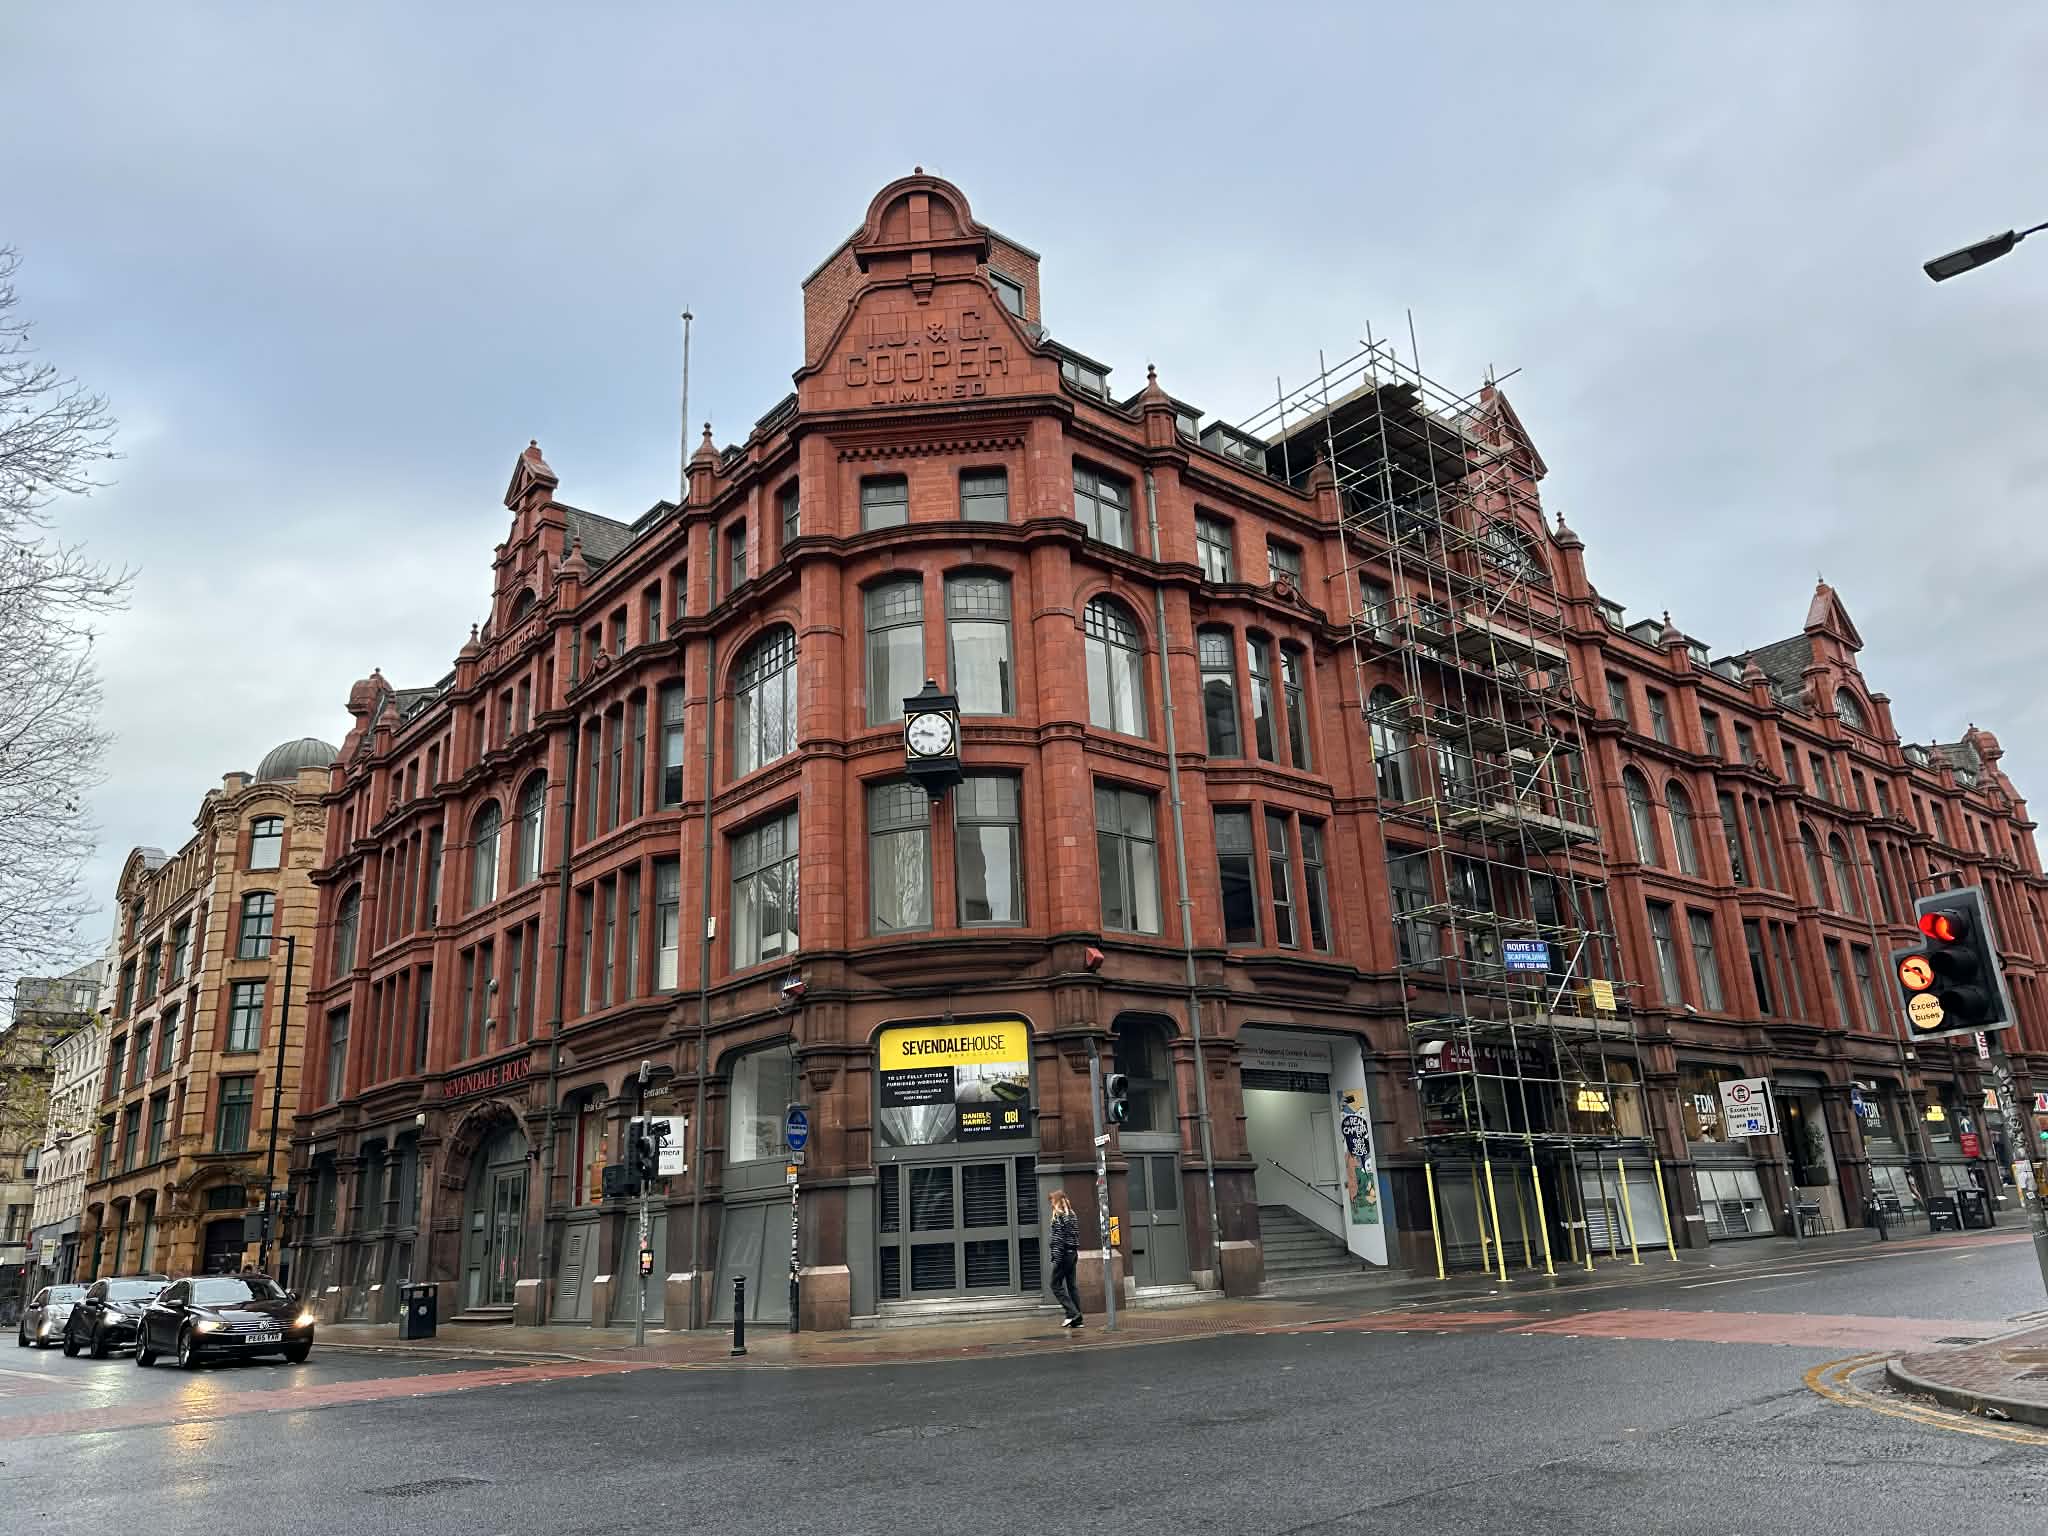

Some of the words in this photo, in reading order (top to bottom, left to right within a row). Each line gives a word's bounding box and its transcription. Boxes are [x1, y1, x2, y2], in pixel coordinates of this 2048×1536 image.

[926, 322, 949, 343] &
[844, 344, 1009, 387] COOPER
[871, 382, 985, 404] LIMITED
[1506, 943, 1530, 952] ROUTE
[1506, 952, 1546, 961] SCAFFOLDING
[1910, 1000, 1940, 1011] Except
[1915, 1013, 1940, 1021] buses
[643, 1086, 669, 1098] Entrance
[1729, 1105, 1748, 1113] Except
[962, 1112, 986, 1120] DANIEL
[1349, 1116, 1366, 1127] REAL
[1343, 1126, 1368, 1136] CAMERA
